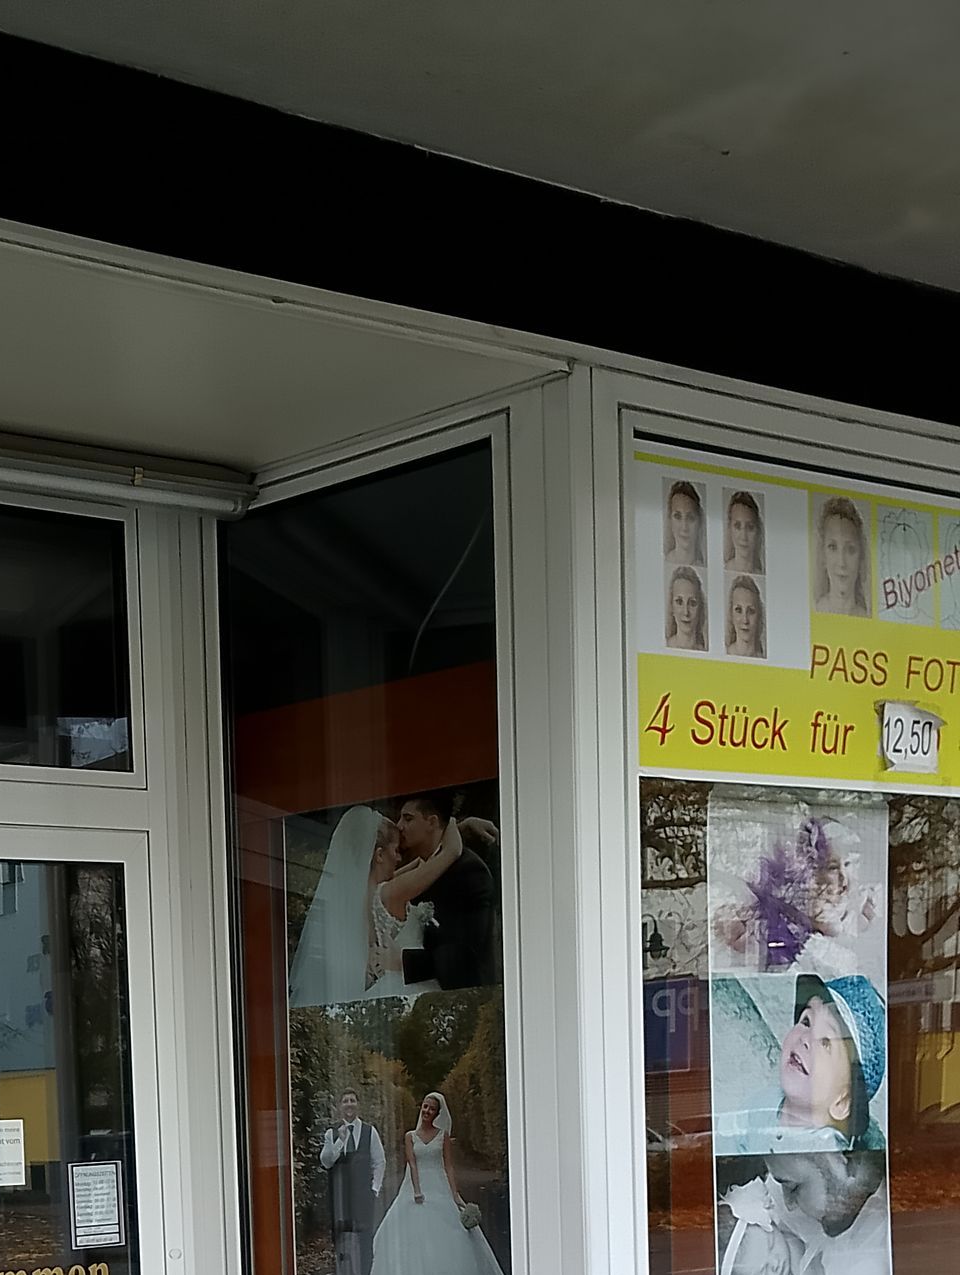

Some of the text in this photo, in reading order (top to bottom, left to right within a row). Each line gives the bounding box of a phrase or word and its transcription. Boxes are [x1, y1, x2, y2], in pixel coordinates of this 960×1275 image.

[810, 644, 960, 694] PASS FOT
[644, 691, 933, 761] 4 Stück für 12,50
